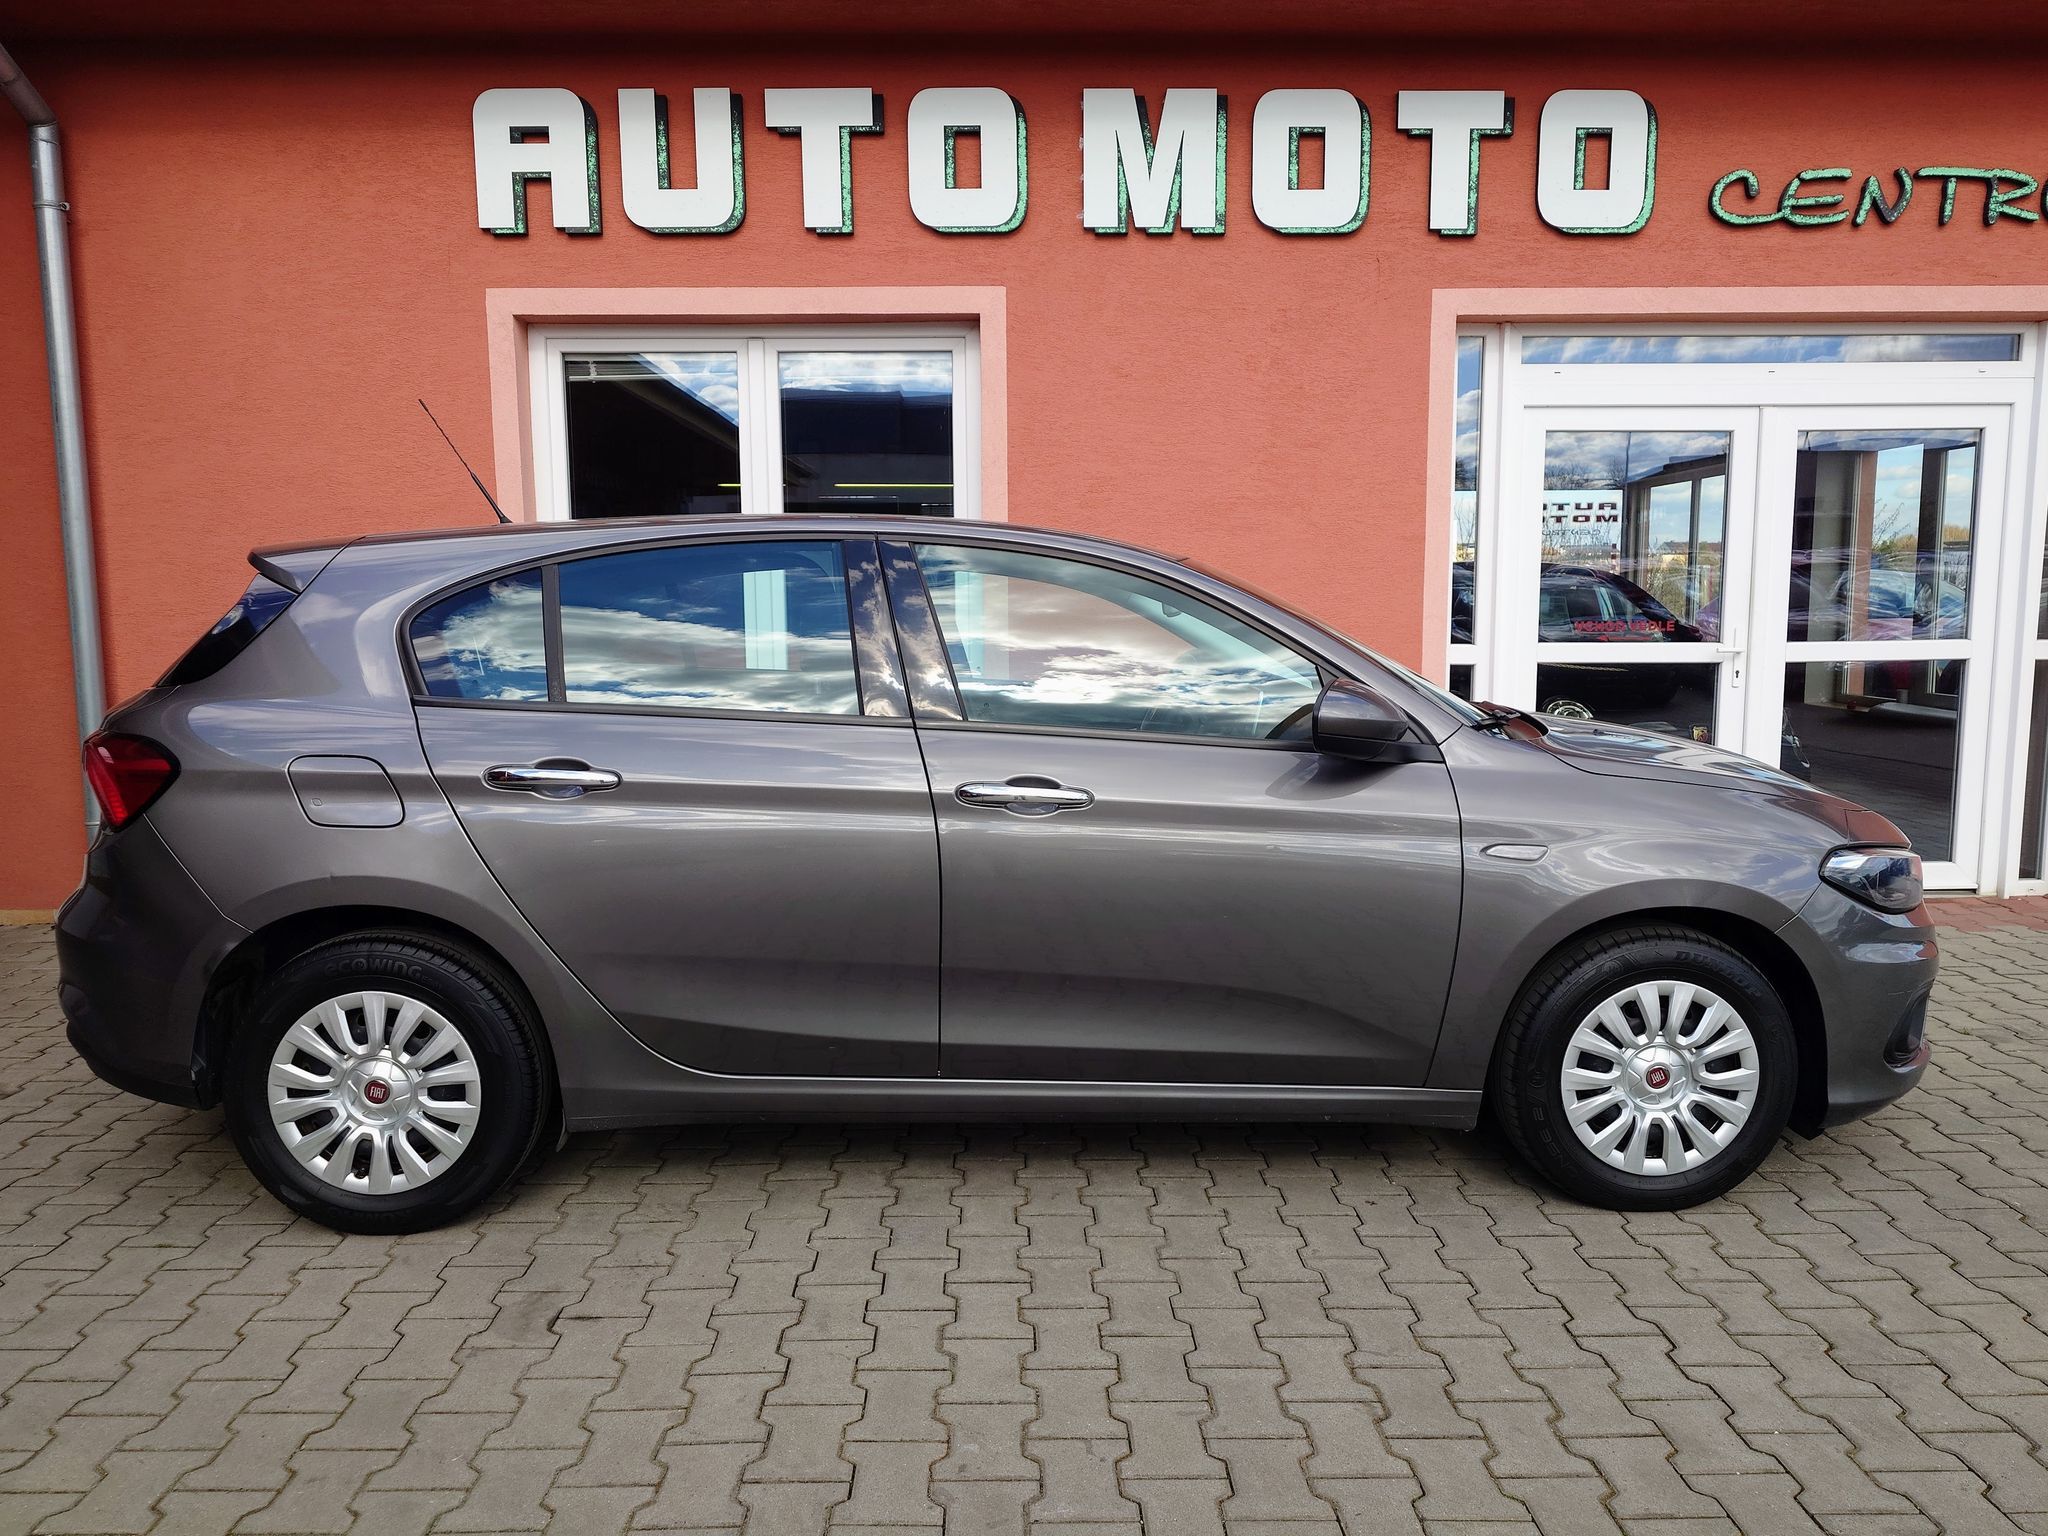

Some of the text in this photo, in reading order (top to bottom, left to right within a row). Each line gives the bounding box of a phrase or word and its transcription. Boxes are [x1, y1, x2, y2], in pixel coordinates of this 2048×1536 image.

[473, 87, 2048, 236] AUTO MOTO CENTR
[1650, 1069, 1665, 1084] FIAT
[370, 1086, 385, 1098] FIAT
